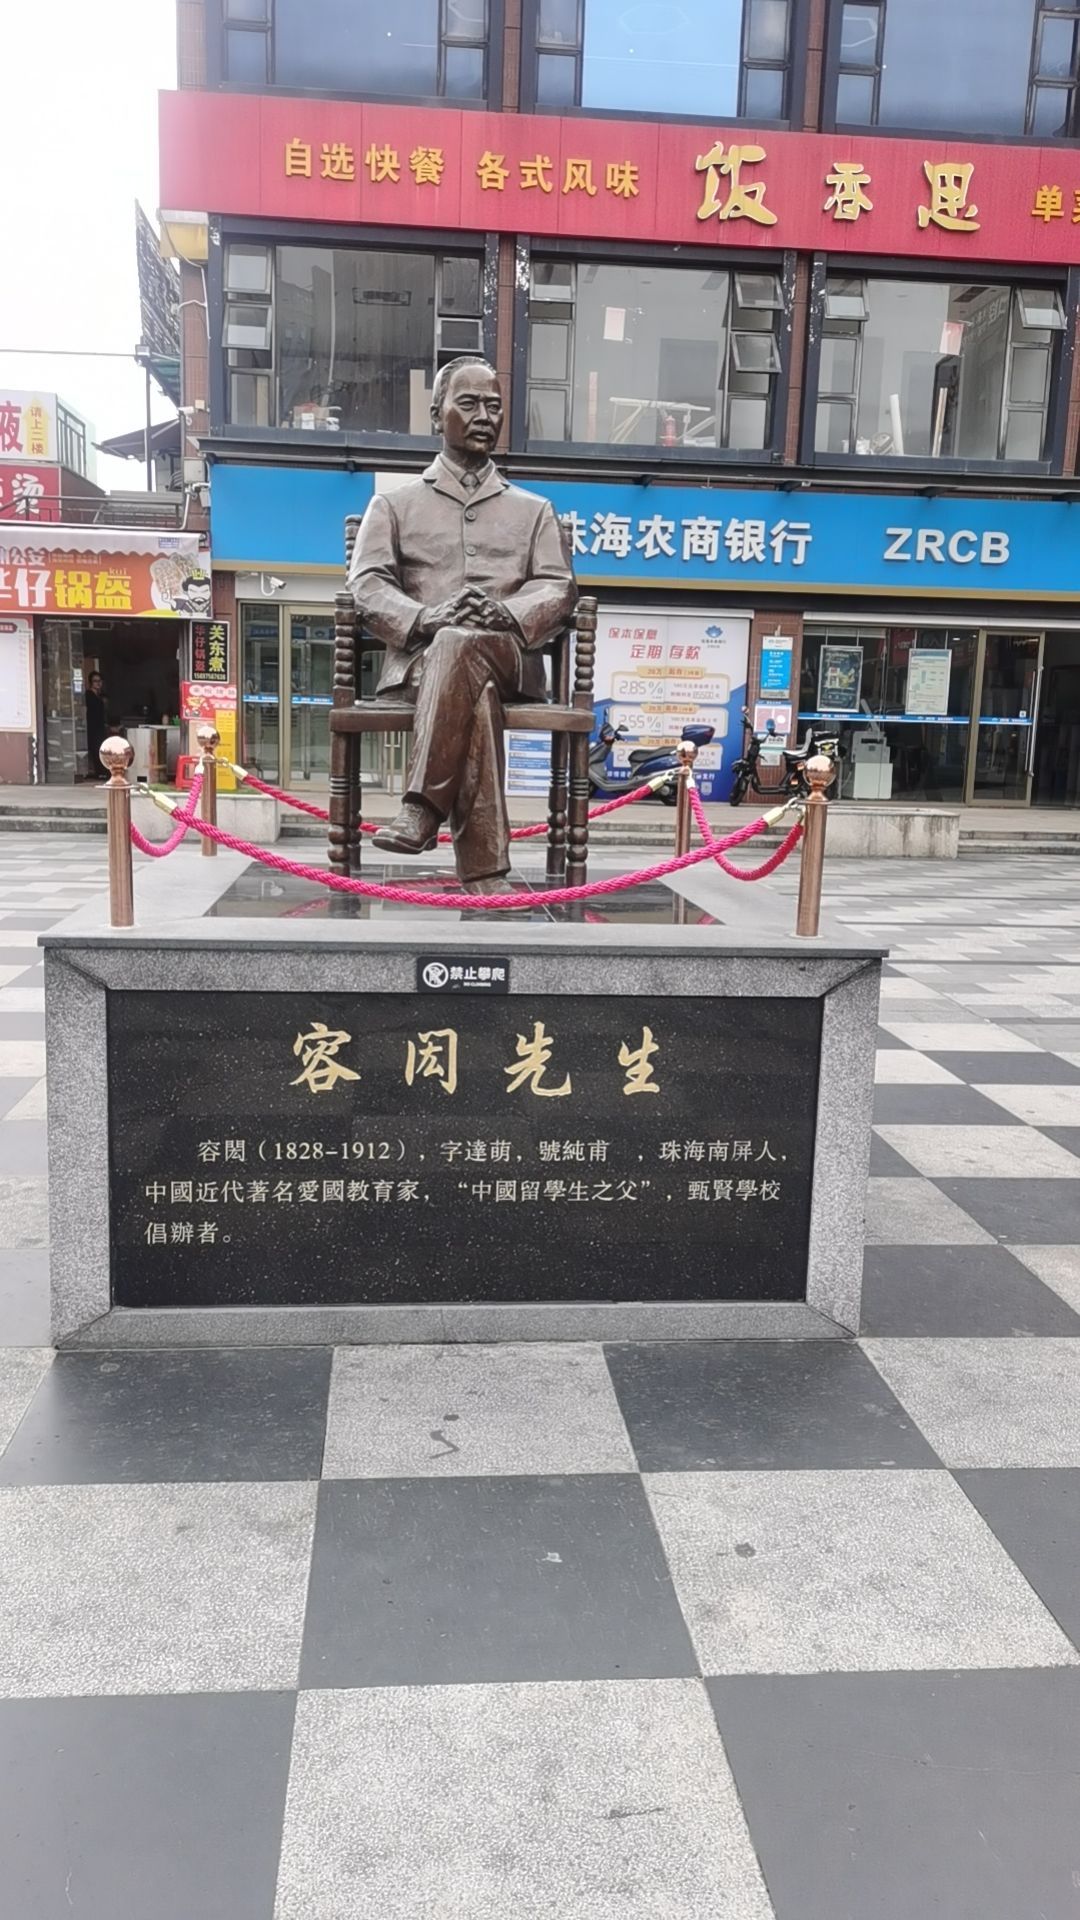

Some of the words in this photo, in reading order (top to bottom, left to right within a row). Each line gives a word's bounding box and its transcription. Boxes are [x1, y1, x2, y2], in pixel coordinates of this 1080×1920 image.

[284, 138, 445, 186] 自选快餐
[476, 151, 641, 197] 各式风味
[1031, 184, 1080, 223] 单
[30, 406, 44, 455] 请上二楼
[0, 473, 45, 514] 烫
[883, 527, 1010, 564] ZRCB
[208, 624, 226, 673] 关东煮
